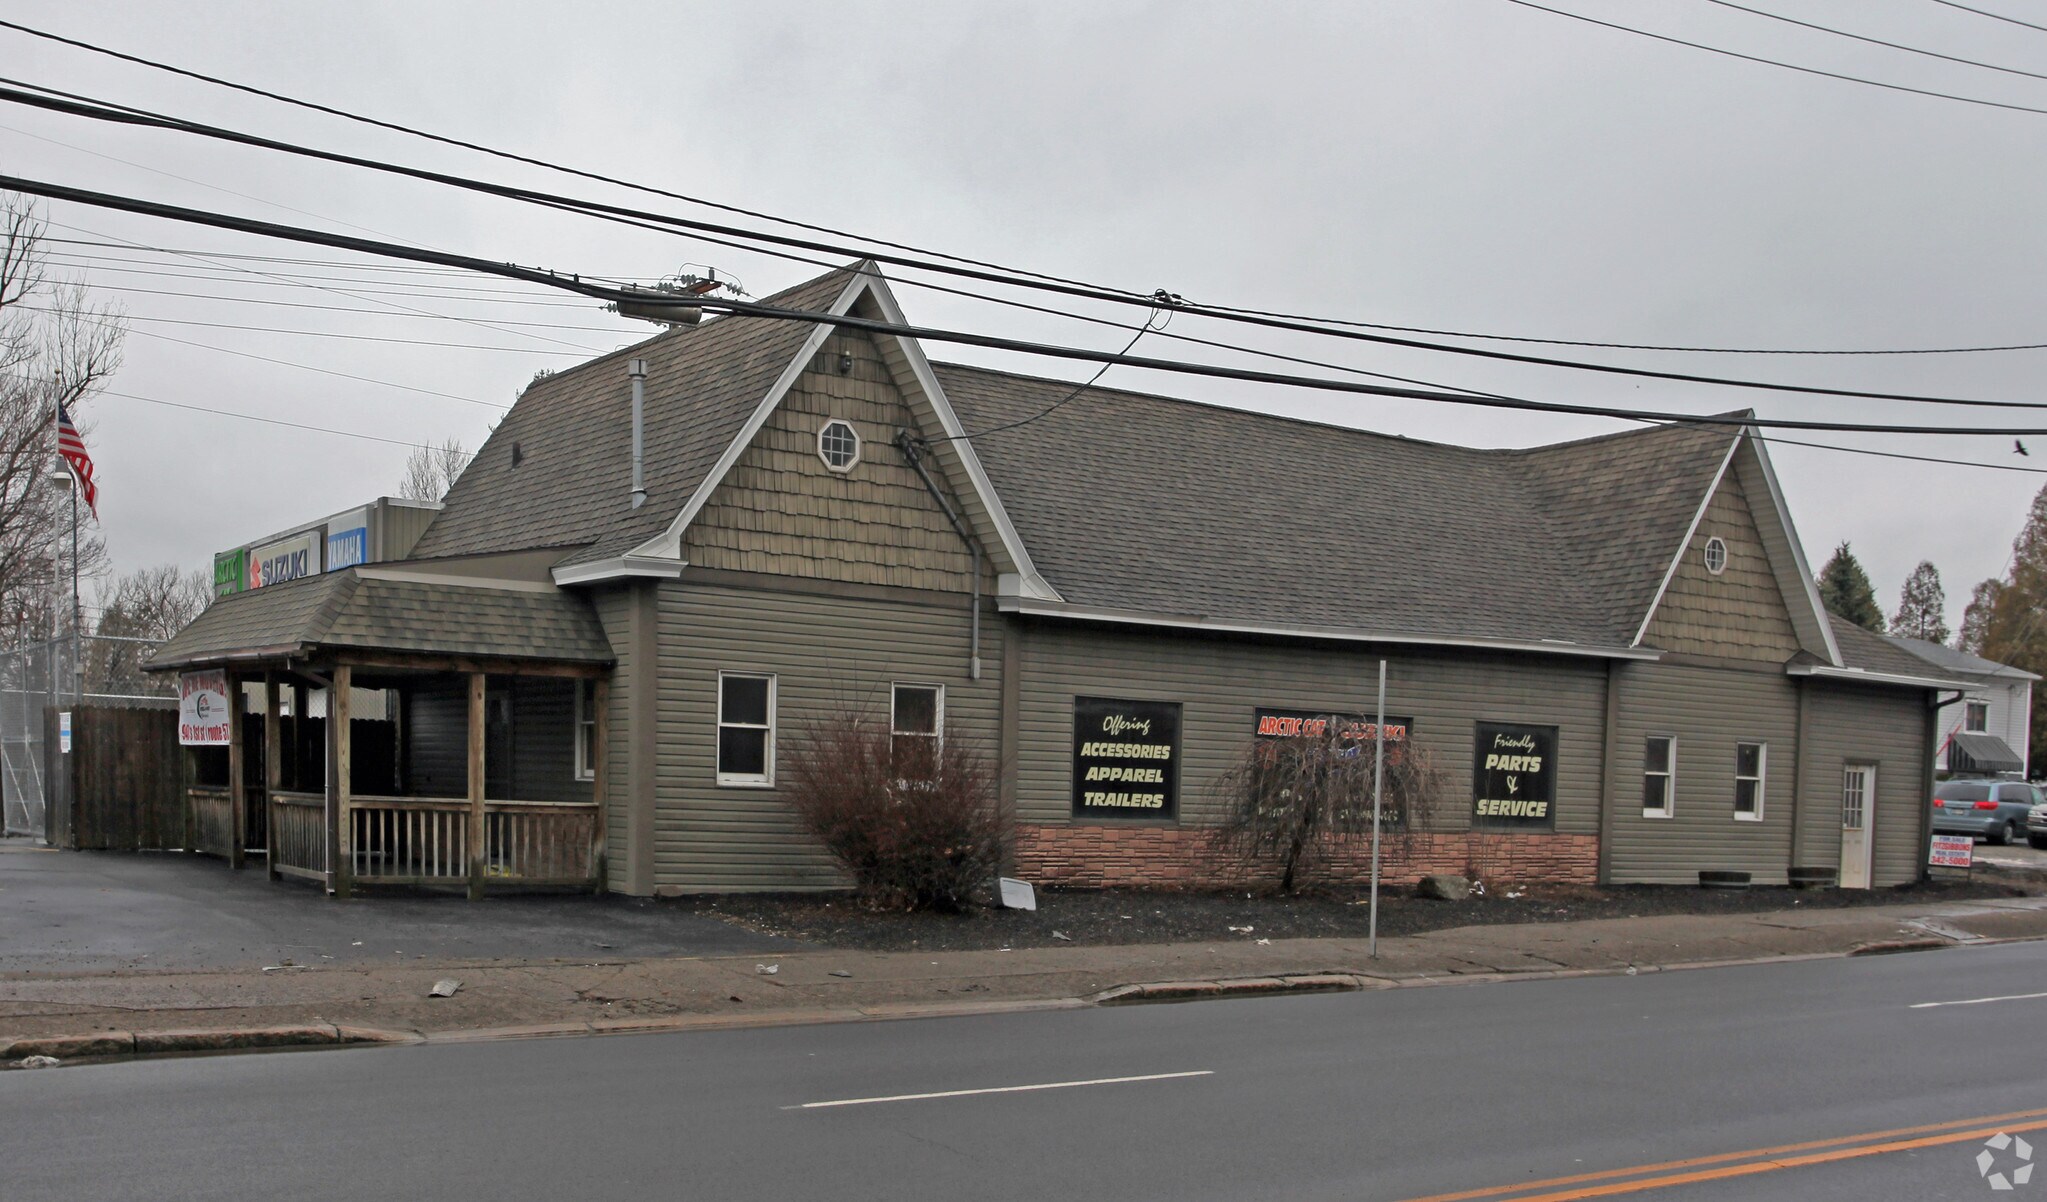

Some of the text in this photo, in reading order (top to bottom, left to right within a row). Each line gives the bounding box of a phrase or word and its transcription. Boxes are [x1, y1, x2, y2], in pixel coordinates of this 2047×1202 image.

[328, 535, 362, 569] YAMAHA
[215, 556, 237, 585] ARCTIC
[262, 548, 308, 587] SUZUKI
[1103, 715, 1151, 736] Offering
[1258, 716, 1302, 736] ARCTIC
[1303, 719, 1326, 738] CAT
[1081, 742, 1171, 760] ACCESSORIES
[1494, 734, 1535, 753] Friendly
[1485, 754, 1542, 772] PARTS
[1085, 767, 1164, 783] APPAREL
[1506, 775, 1519, 794] &
[1084, 792, 1164, 808] TRAILERS
[1477, 799, 1548, 817] SERVICE
